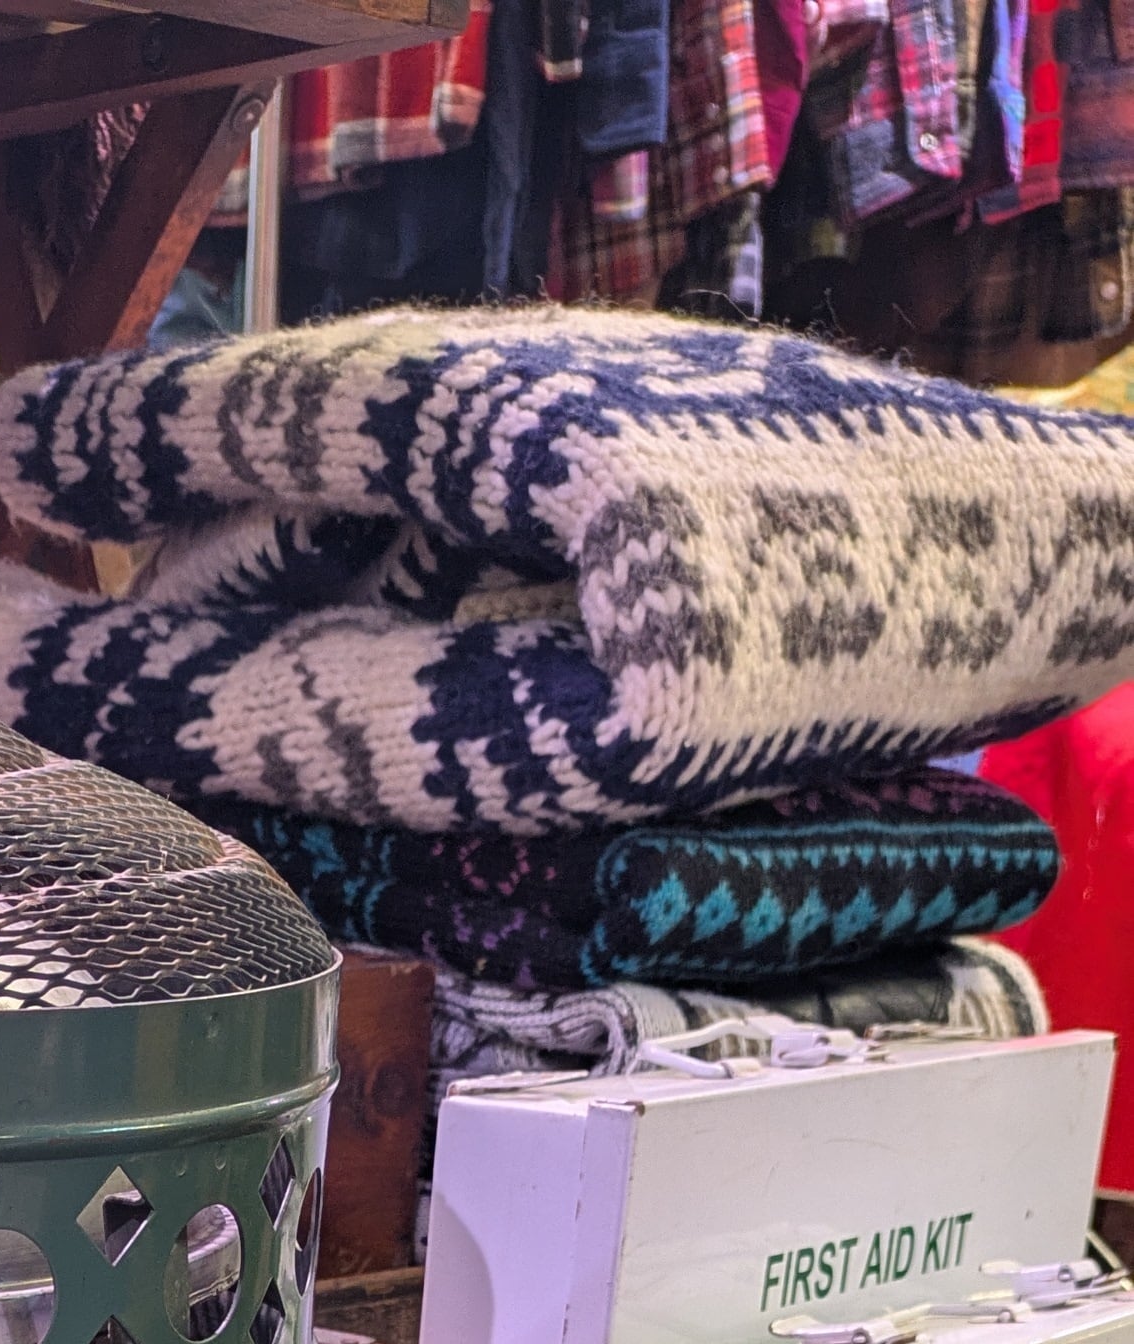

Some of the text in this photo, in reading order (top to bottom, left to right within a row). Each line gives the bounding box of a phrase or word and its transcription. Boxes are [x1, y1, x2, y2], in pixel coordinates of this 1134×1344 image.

[760, 1212, 974, 1312] FIRST AID KIT
